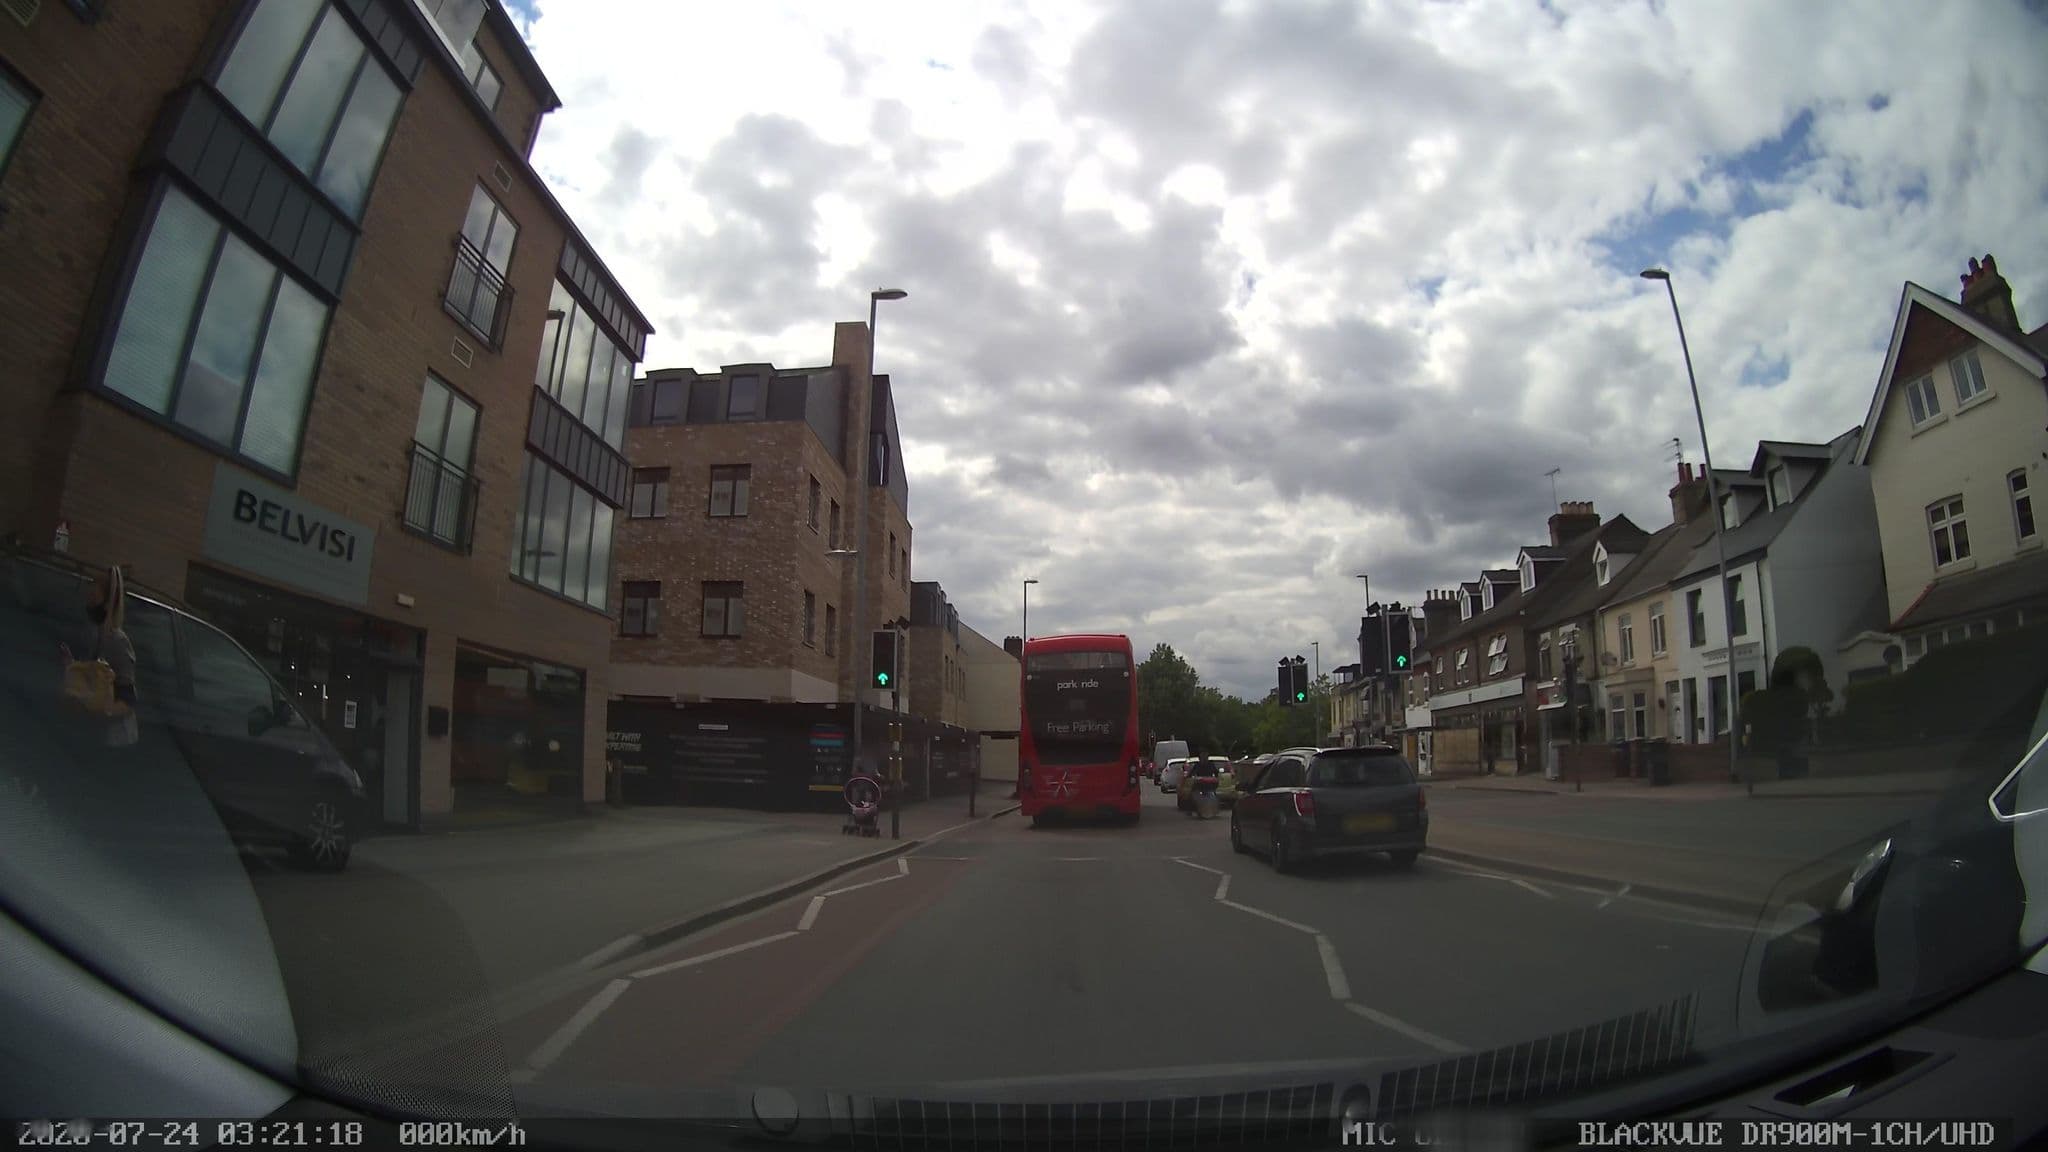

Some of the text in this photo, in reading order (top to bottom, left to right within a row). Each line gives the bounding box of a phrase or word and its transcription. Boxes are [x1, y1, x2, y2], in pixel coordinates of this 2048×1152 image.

[233, 488, 356, 562] BELVISI
[1057, 679, 1078, 691] park
[1047, 722, 1070, 733] Free
